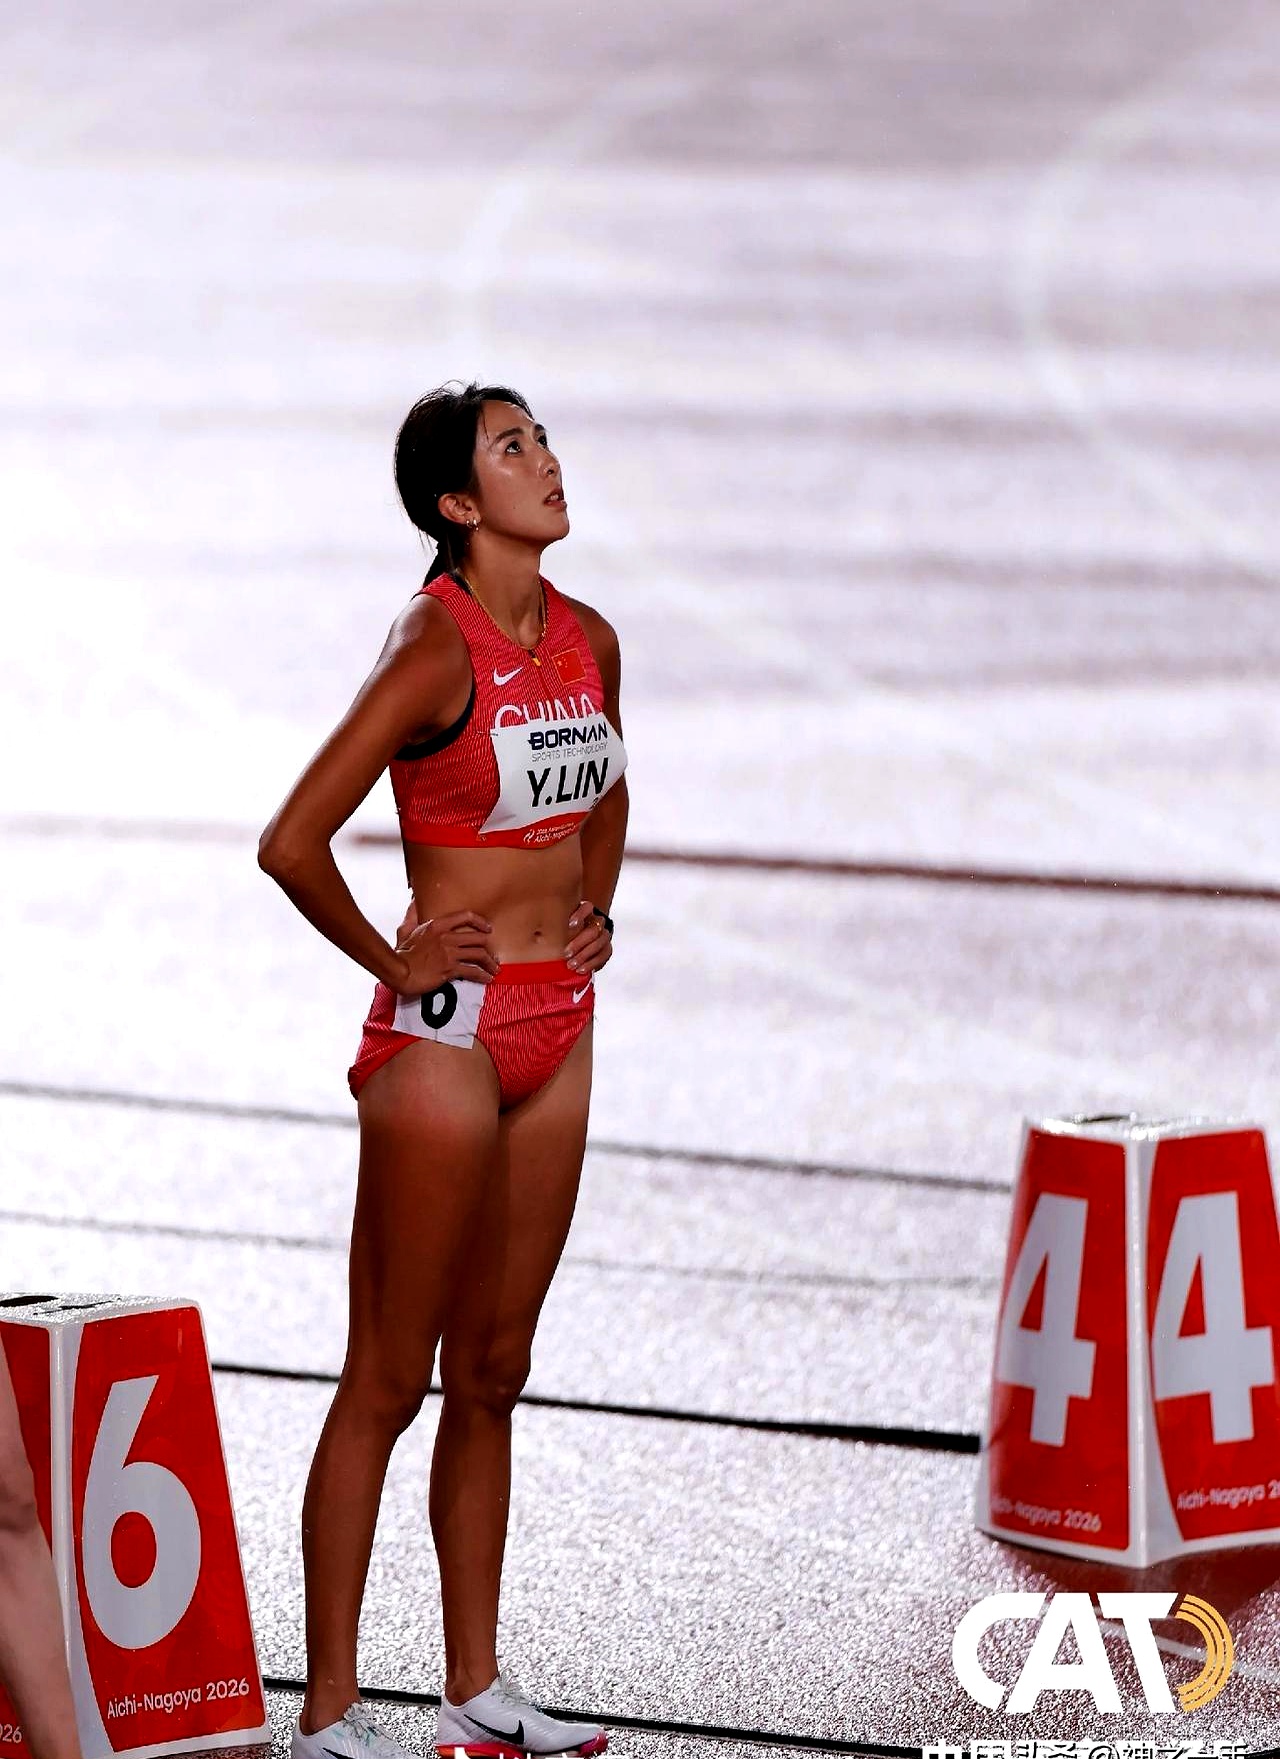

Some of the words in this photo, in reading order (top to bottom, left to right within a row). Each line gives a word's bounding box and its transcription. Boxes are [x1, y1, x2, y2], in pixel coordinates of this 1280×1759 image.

[528, 722, 608, 751] BORNAN
[532, 749, 561, 762] SPORTS
[563, 742, 608, 758] TECHNOLOGY
[527, 757, 609, 807] Y.LIN
[997, 1192, 1097, 1447] 4
[1151, 1190, 1275, 1446] 4
[82, 1374, 201, 1650] 6
[1063, 1508, 1102, 1533] 2026
[107, 1686, 201, 1719] Aichi-Nagoya
[205, 1678, 251, 1702] 2026
